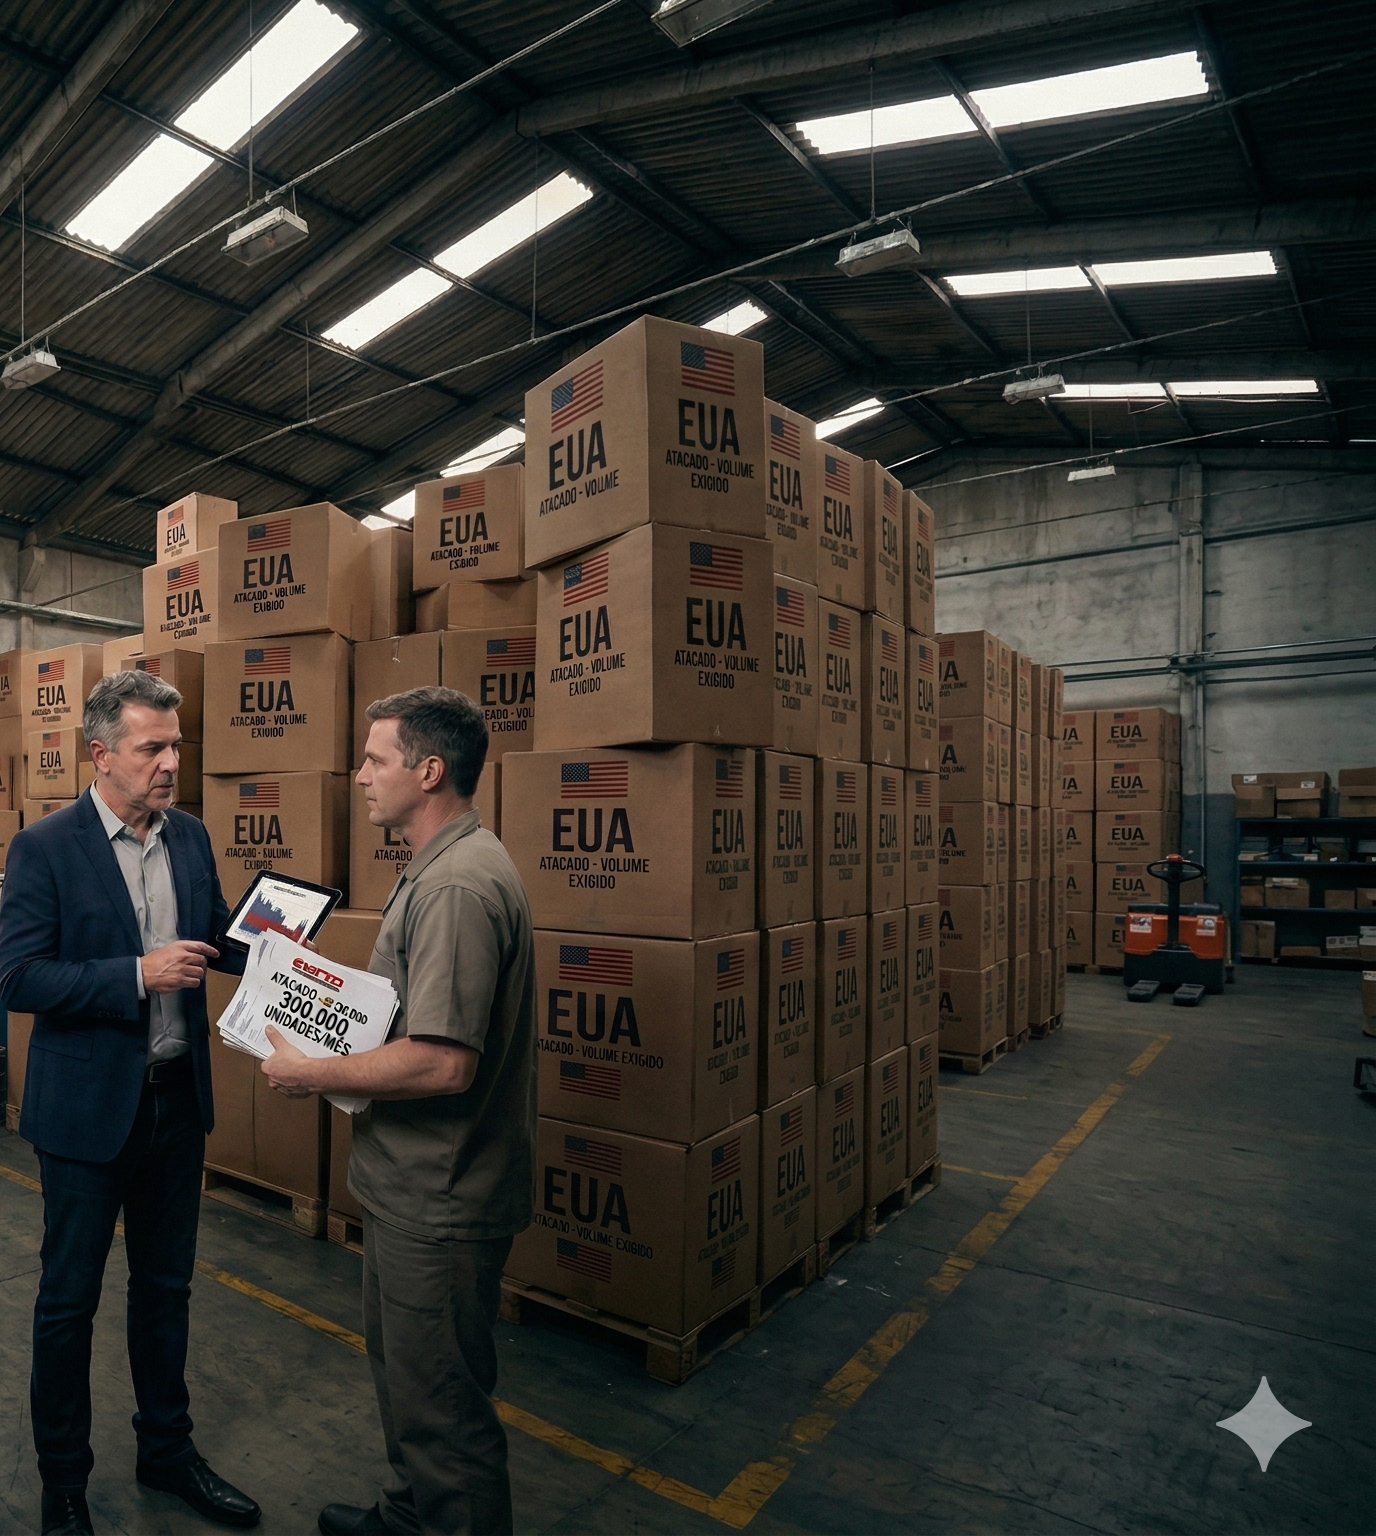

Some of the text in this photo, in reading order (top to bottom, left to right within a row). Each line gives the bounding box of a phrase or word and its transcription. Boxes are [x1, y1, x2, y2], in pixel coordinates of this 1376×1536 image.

[678, 398, 740, 456] EUA
[549, 420, 607, 491] EUA
[665, 449, 709, 471] ATACADO
[539, 487, 576, 517] ATACADO
[769, 460, 803, 510] EUA
[167, 523, 186, 546] EUA
[440, 511, 488, 547] EUA
[823, 495, 853, 542] EUA
[243, 553, 294, 589] EUA
[166, 589, 204, 621] EUA
[560, 605, 612, 662] EUA
[686, 596, 747, 651] EUA
[674, 649, 716, 669] ATACADO
[775, 632, 807, 677] EUA
[480, 671, 536, 706] EUA
[827, 653, 852, 695] EUA
[880, 666, 899, 705] EUA
[37, 685, 66, 707] EUA
[240, 680, 295, 713] EUA
[273, 713, 307, 725] VOLUME
[1110, 725, 1142, 738] EUA
[40, 751, 61, 768] EUA
[1111, 776, 1143, 788] EUA
[234, 814, 283, 845] EUA
[552, 808, 635, 853] EUA
[712, 809, 745, 854] EUA
[777, 809, 803, 850] EUA
[834, 811, 858, 849] EUA
[879, 814, 898, 848] EUA
[913, 814, 933, 846] EUA
[1112, 827, 1144, 840] EUA
[539, 857, 650, 873] ATACADO VOLUME
[569, 875, 616, 889] EXIGIDO
[1112, 878, 1145, 891] EUA
[271, 971, 318, 1001] ATACADO
[835, 966, 858, 1007] EUA
[880, 957, 899, 993] EUA
[279, 991, 350, 1037] 300.000
[548, 988, 642, 1047] EUA
[779, 979, 806, 1026] EUA
[713, 996, 746, 1050] EUA
[582, 1045, 619, 1063] VOLUME
[880, 1096, 899, 1138] EUA
[832, 1118, 855, 1164] EUA
[777, 1144, 806, 1198] EUA
[544, 1165, 632, 1235] EUA
[707, 1179, 744, 1241] EUA
